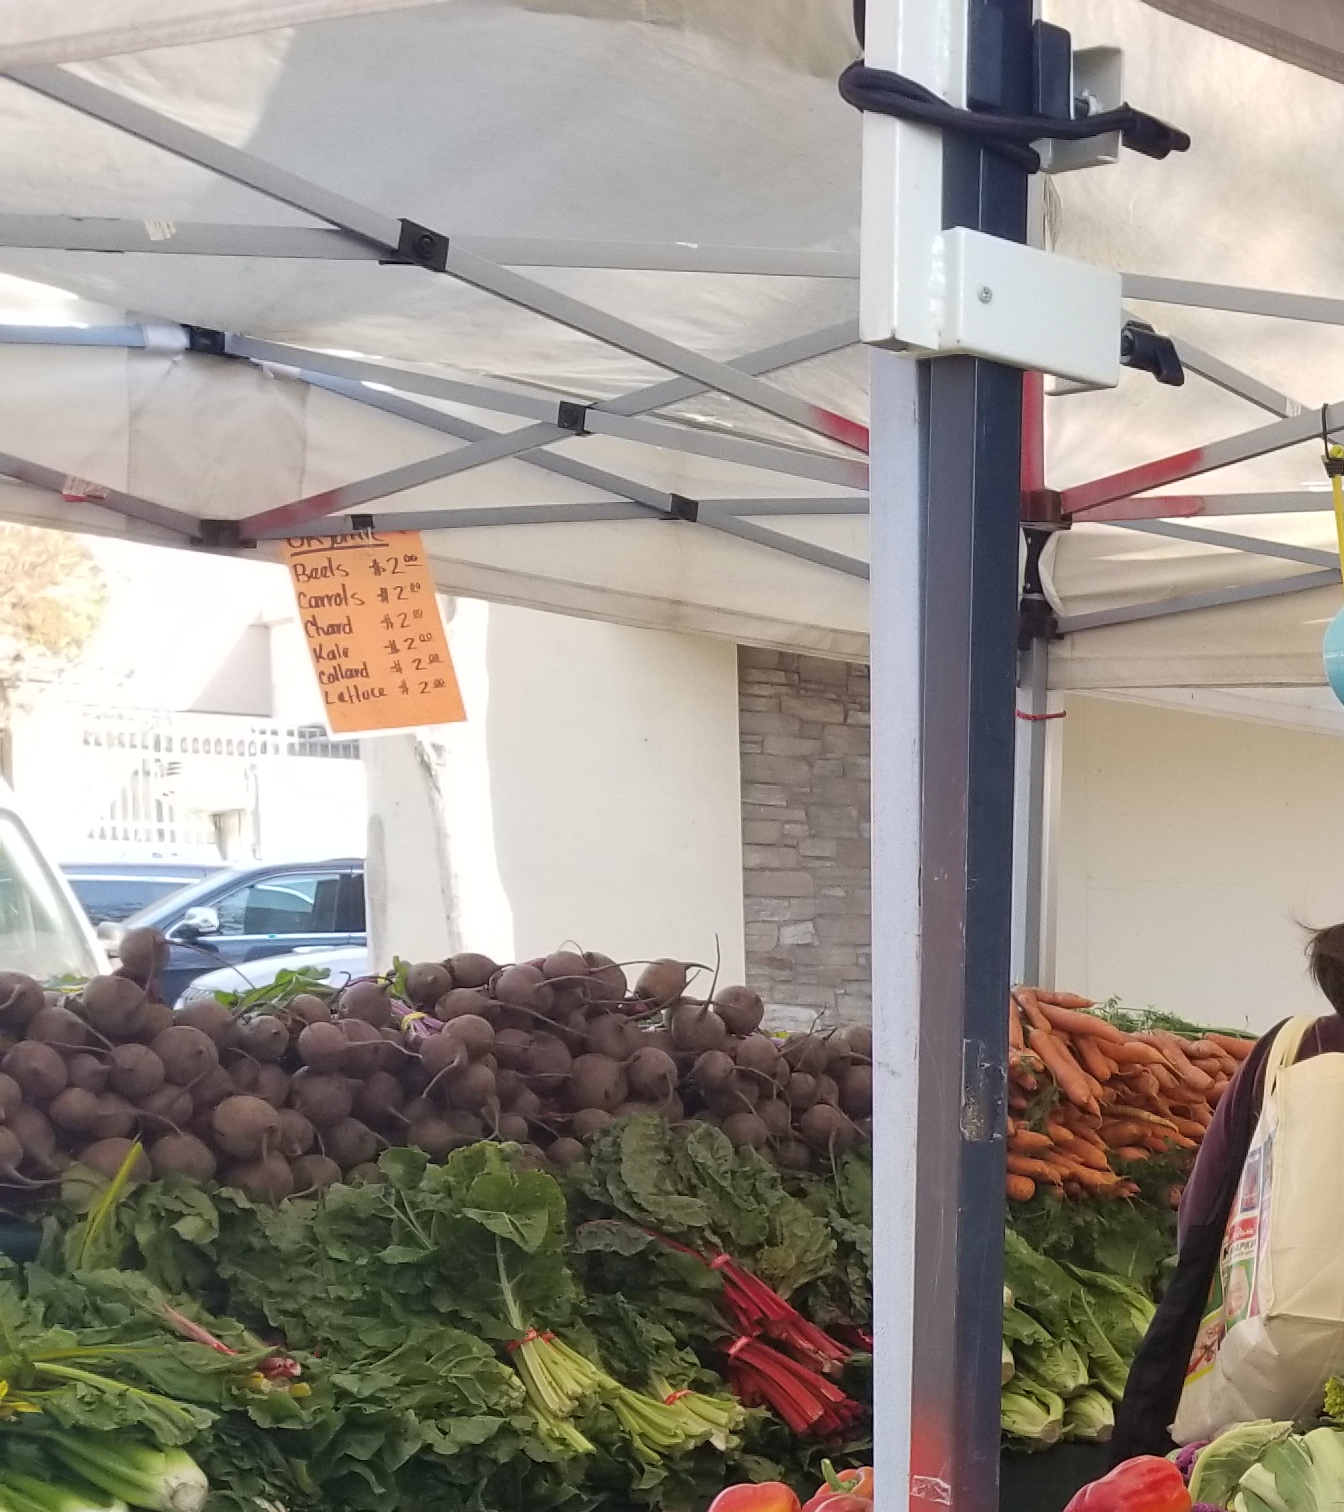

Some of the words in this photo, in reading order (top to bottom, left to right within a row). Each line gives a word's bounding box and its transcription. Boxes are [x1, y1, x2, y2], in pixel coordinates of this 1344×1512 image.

[305, 614, 353, 638] Chard
[313, 643, 349, 663] Kale
[319, 661, 369, 685] Collard
